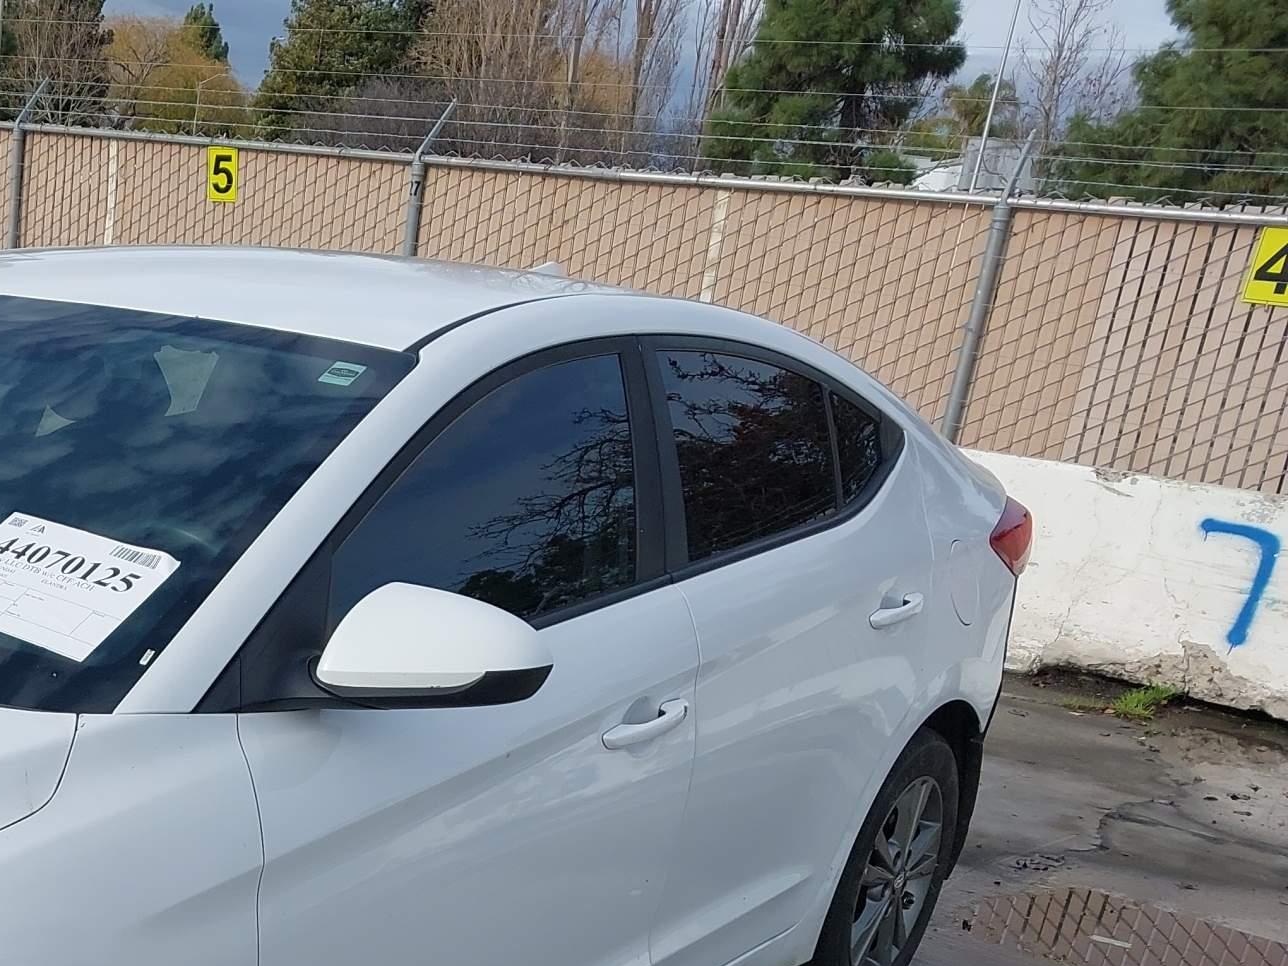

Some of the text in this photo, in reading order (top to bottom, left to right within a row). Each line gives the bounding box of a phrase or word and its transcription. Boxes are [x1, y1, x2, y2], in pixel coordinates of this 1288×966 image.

[211, 153, 234, 195] 5
[1253, 242, 1288, 295] 4
[1199, 516, 1281, 648] 7
